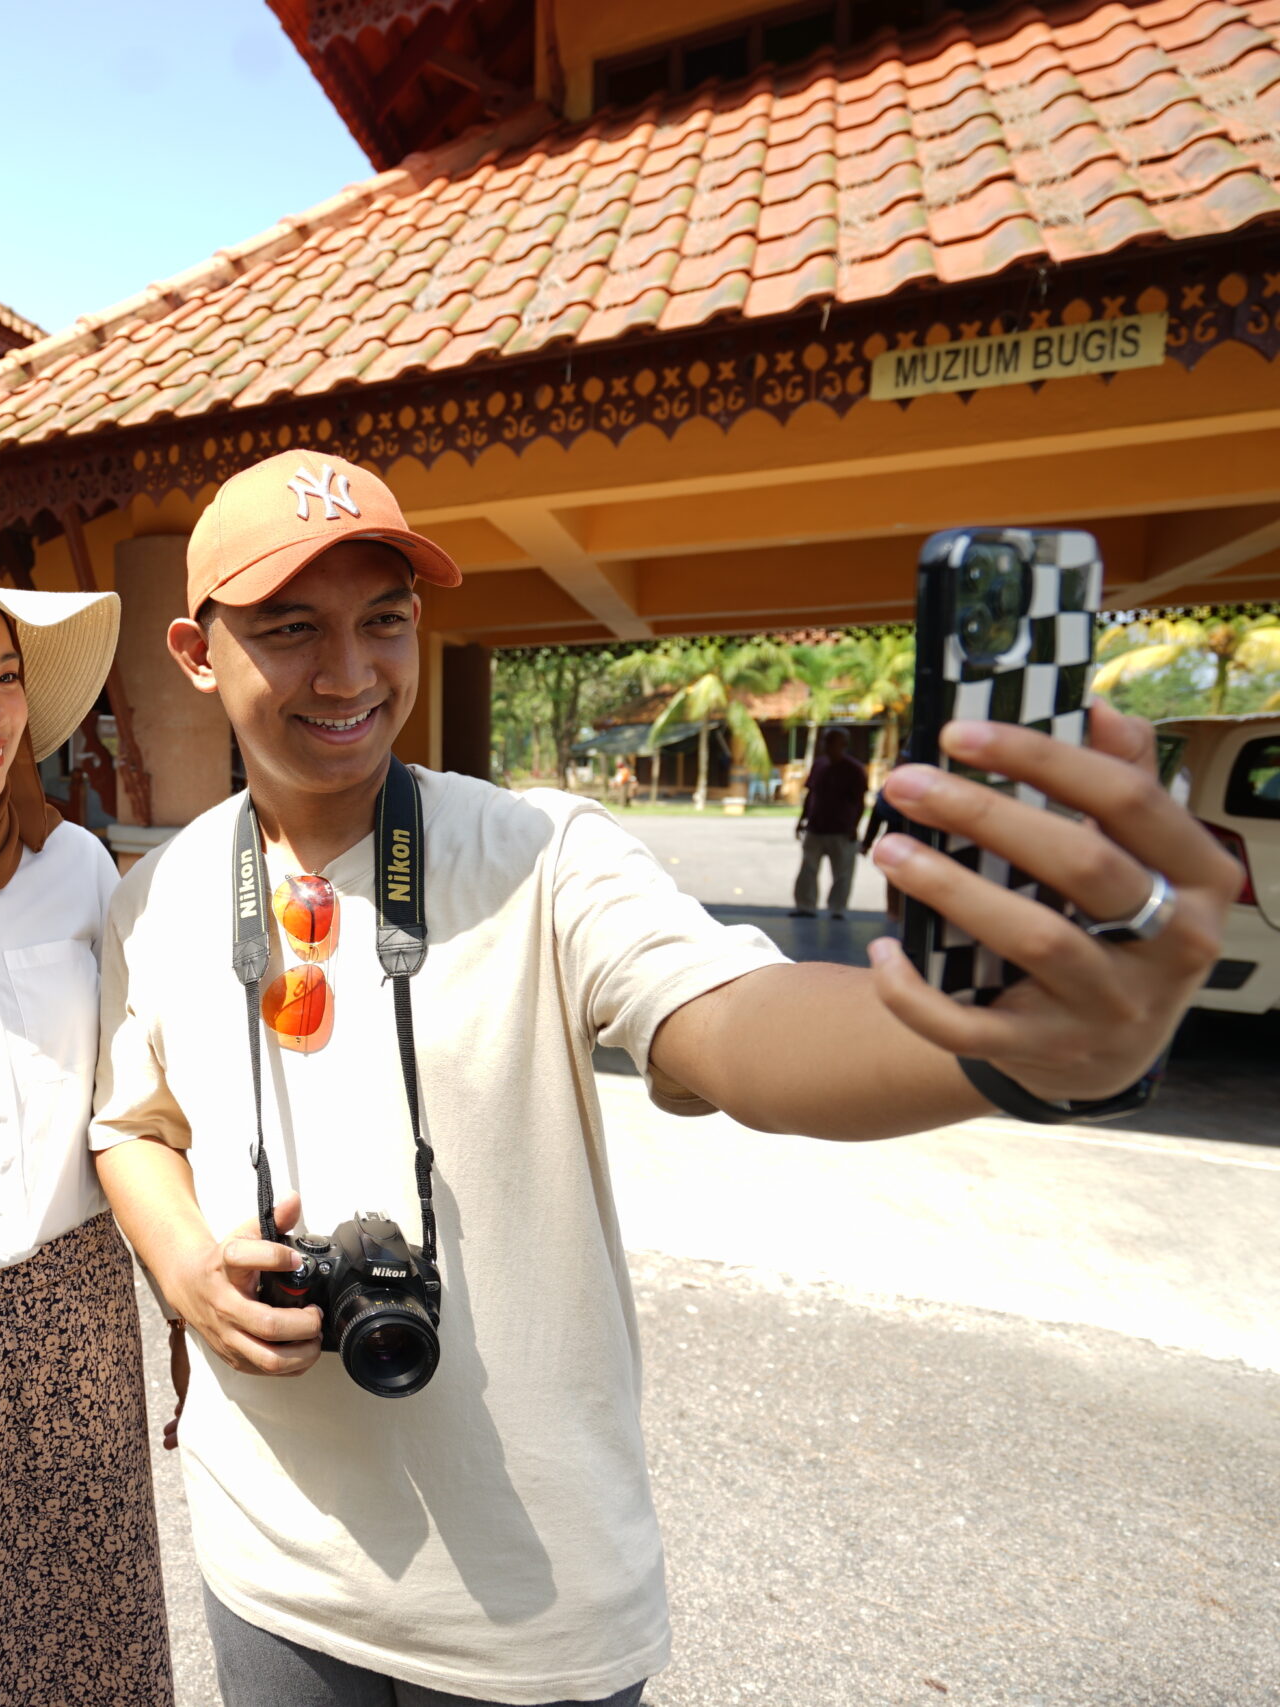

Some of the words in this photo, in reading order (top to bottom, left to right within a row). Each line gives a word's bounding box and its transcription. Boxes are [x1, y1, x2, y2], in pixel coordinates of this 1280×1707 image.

[894, 340, 1020, 389] MUZIUM
[1032, 323, 1143, 371] BUGIS
[239, 849, 257, 918] Nikon
[387, 828, 411, 903] Nikon
[372, 1267, 406, 1277] Nikon
